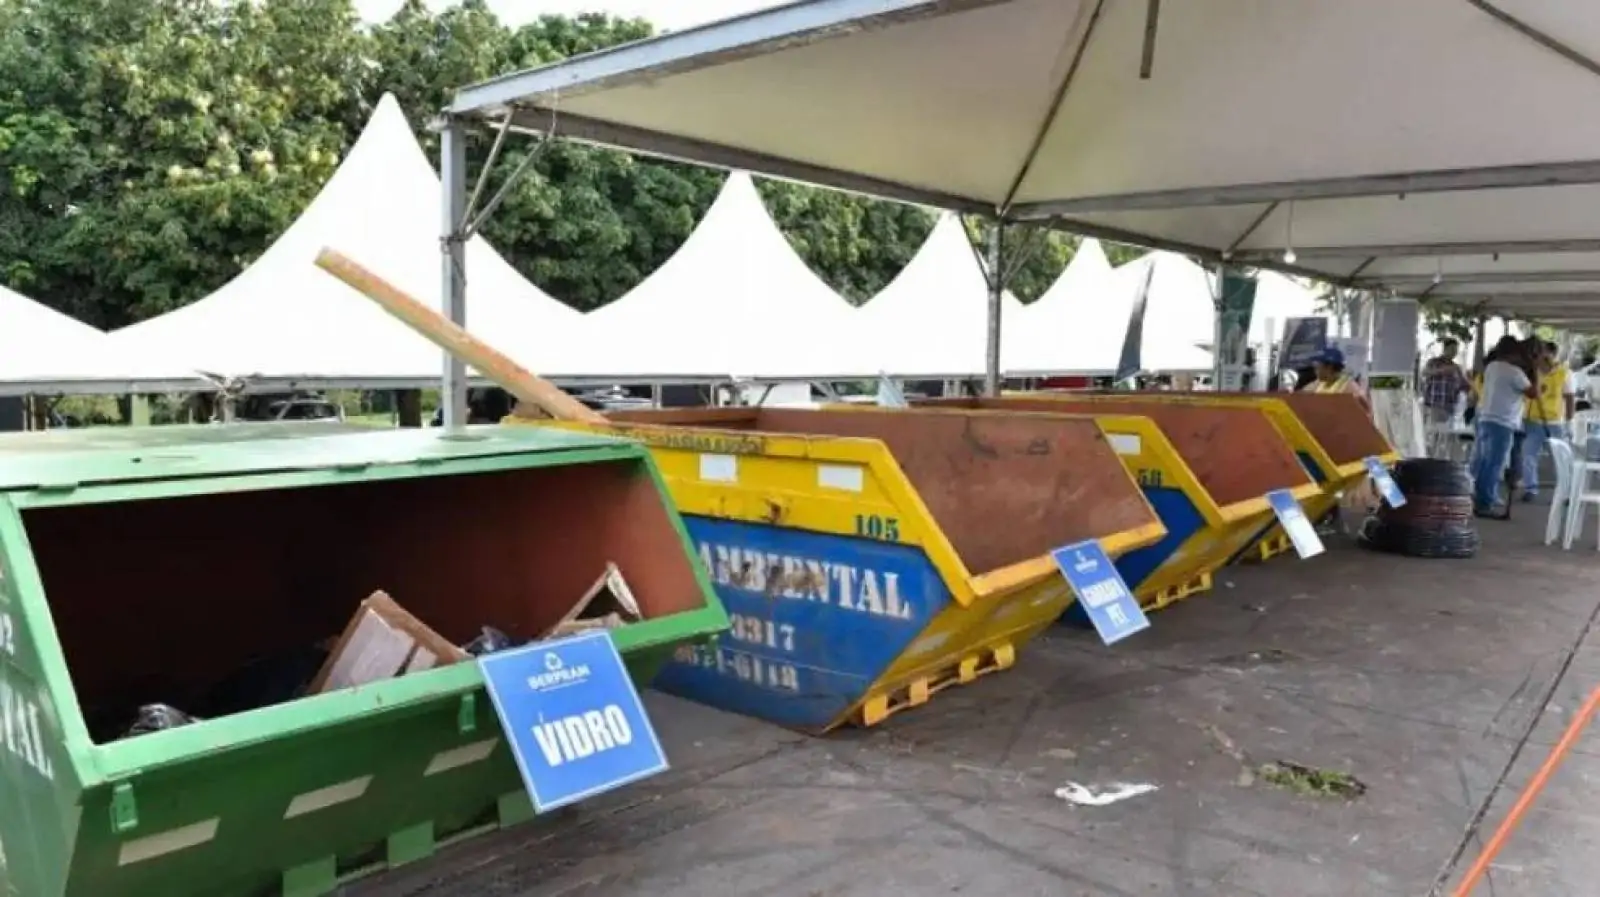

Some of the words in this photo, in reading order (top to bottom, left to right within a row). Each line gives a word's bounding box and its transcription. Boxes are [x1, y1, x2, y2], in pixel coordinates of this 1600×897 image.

[855, 514, 900, 542] 105
[699, 541, 911, 619] AMBIENTAL
[531, 704, 633, 768] VIDRO
